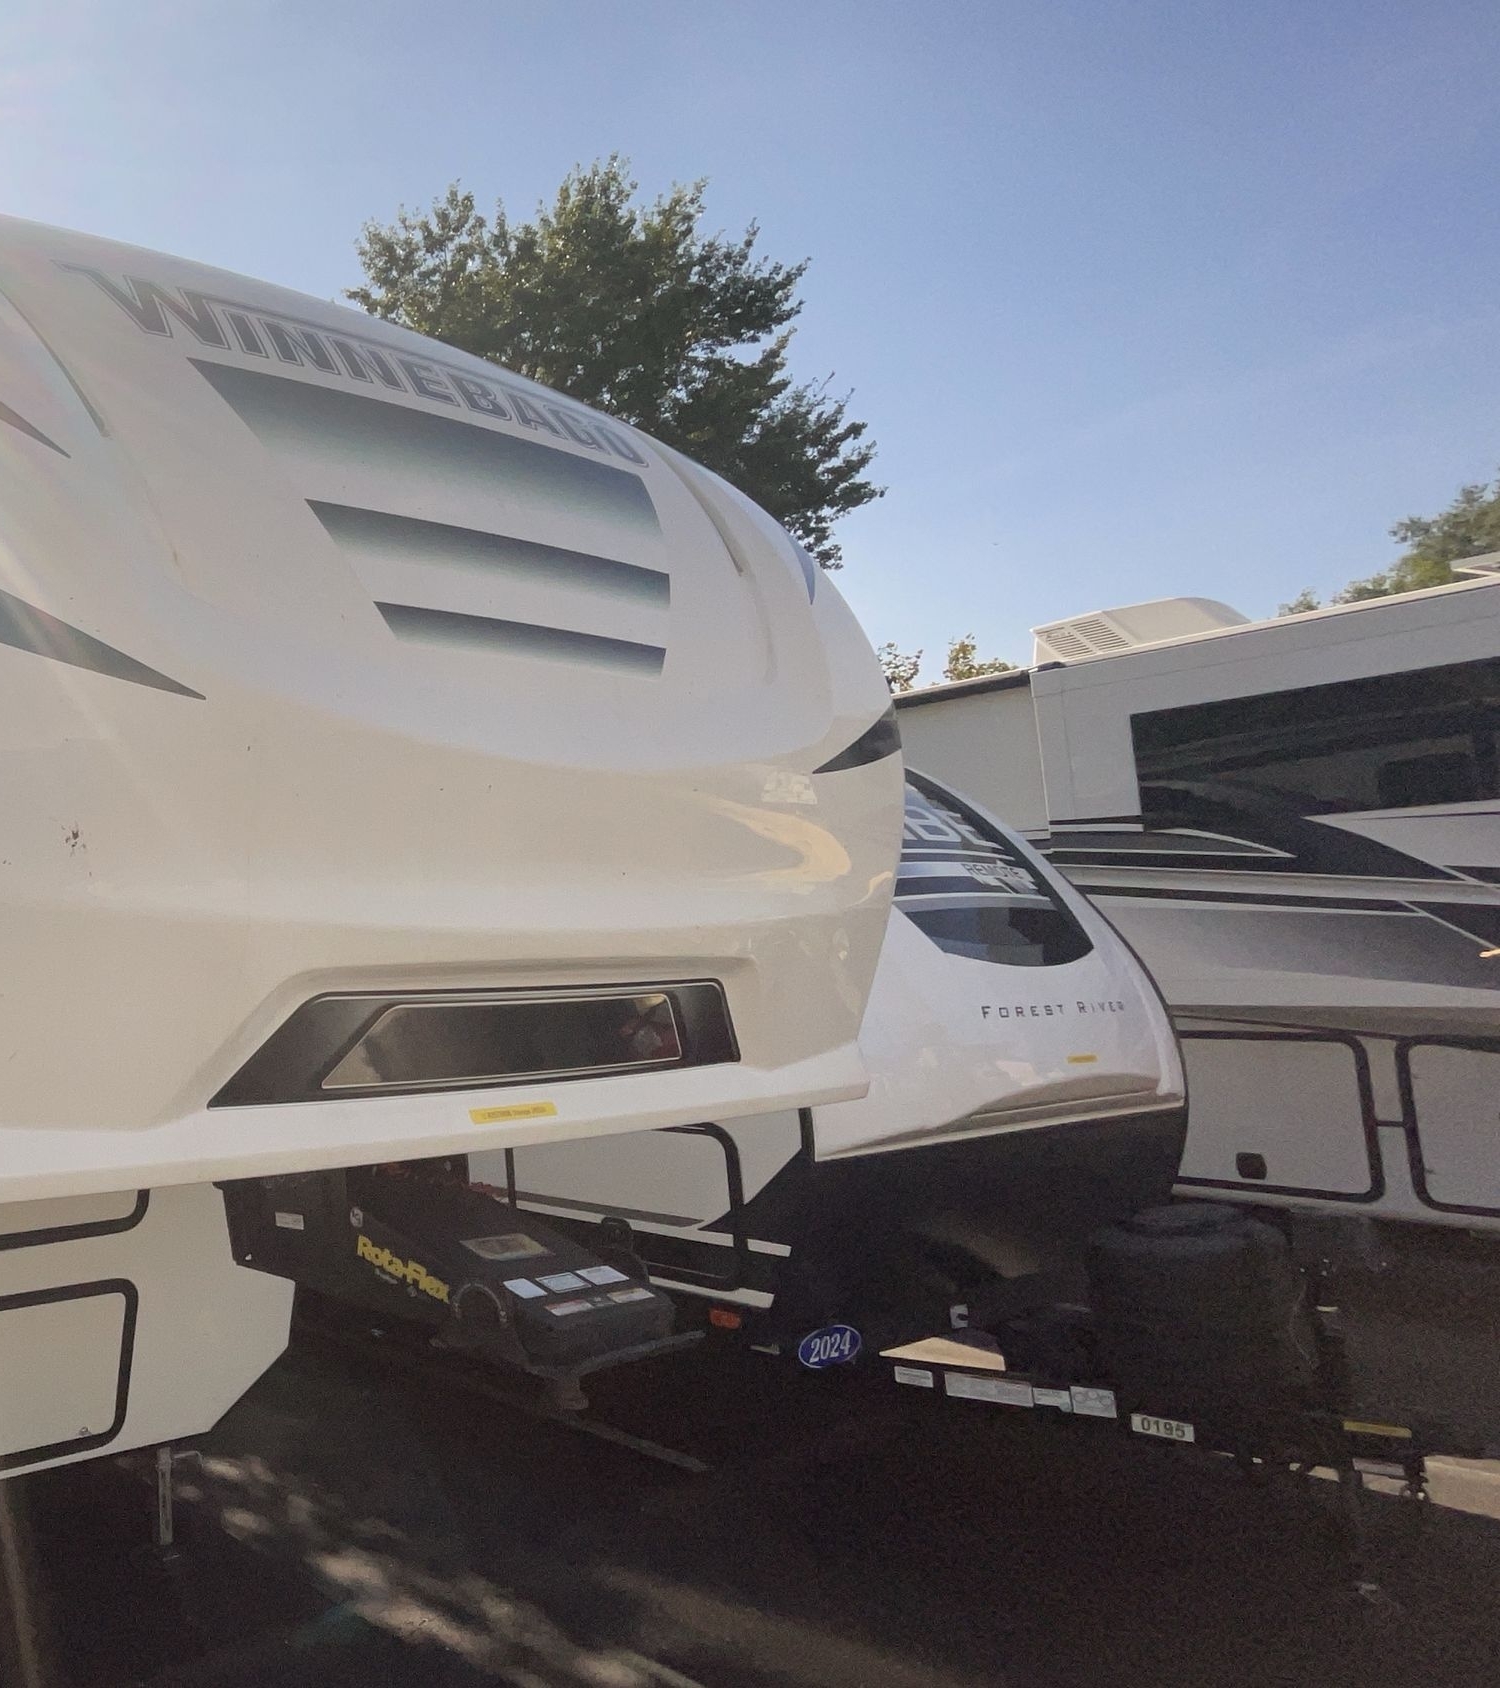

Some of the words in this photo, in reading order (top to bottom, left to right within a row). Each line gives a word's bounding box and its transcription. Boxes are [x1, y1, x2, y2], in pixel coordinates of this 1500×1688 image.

[51, 259, 649, 468] WINNEBAGO
[981, 1004, 1066, 1020] FOREST
[1076, 1001, 1125, 1014] RIVER
[809, 1330, 851, 1364] 2024
[1141, 1417, 1186, 1439] 0195
